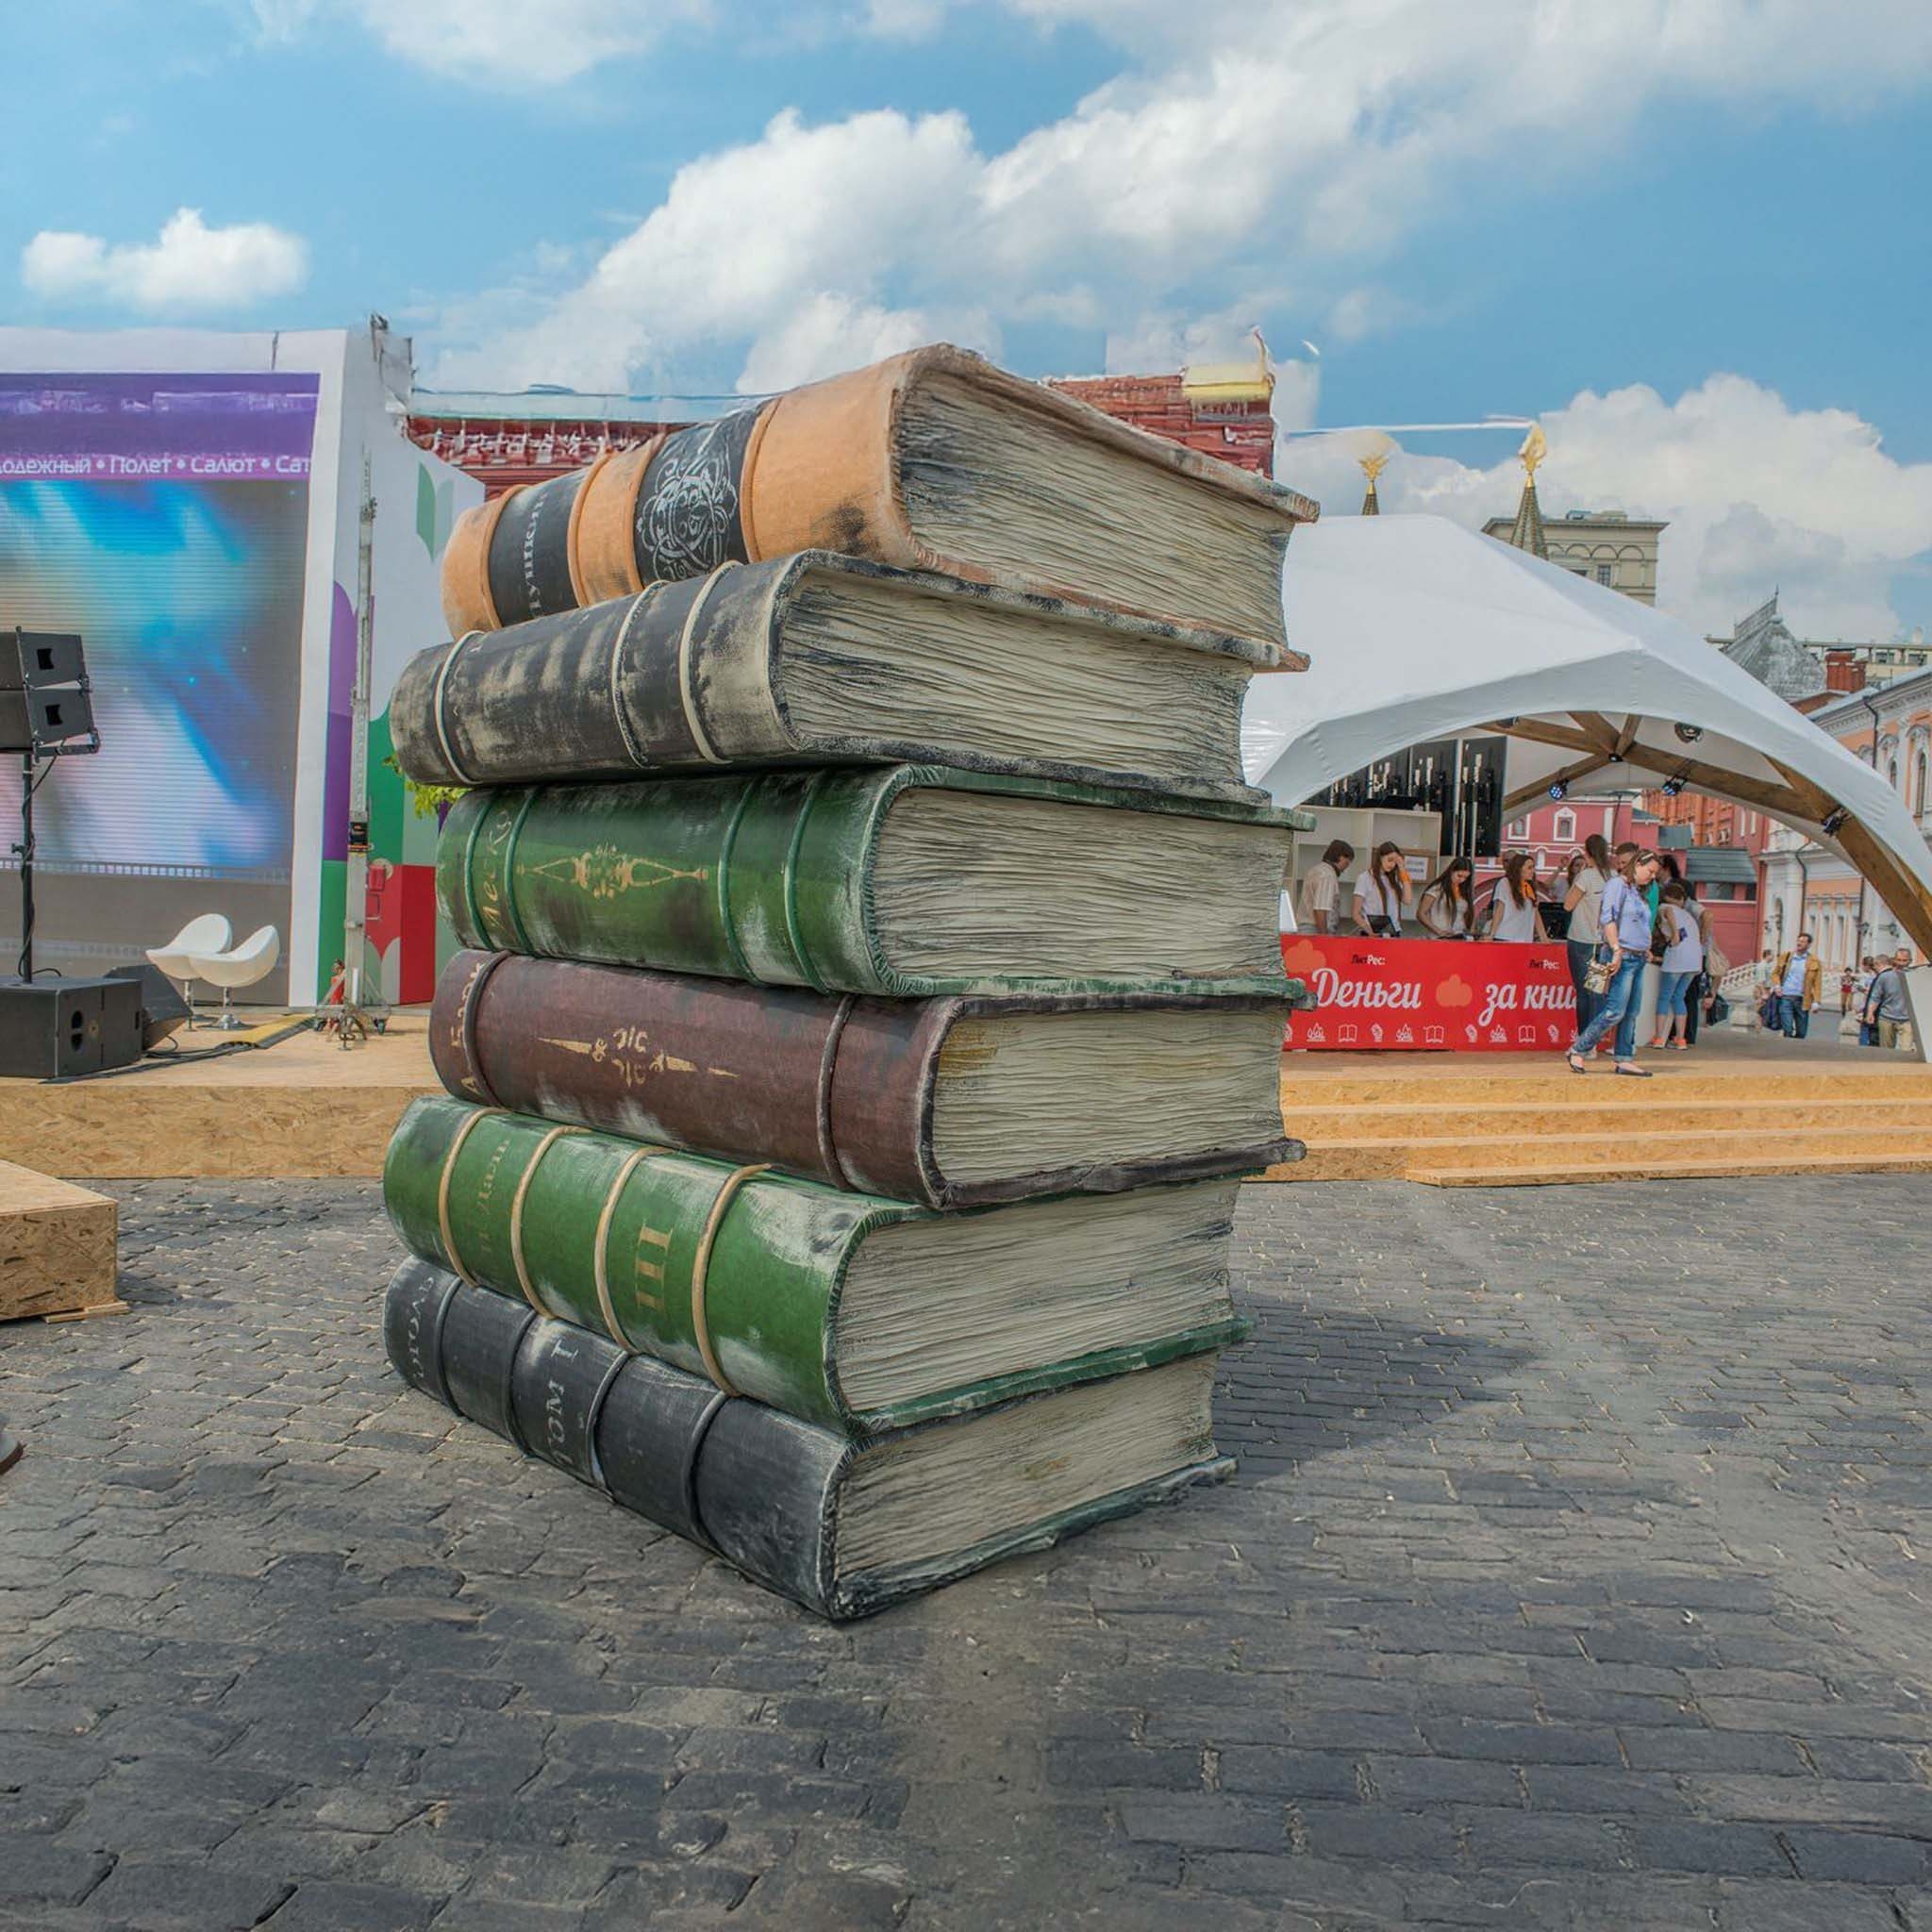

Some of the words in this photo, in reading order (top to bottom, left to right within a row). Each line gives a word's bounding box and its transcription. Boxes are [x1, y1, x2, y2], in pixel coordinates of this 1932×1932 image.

[0, 455, 92, 475] одежный
[109, 455, 171, 474] Полет
[191, 456, 257, 474] Салют
[275, 457, 311, 474] Сат
[1312, 968, 1422, 1009] Деньги
[1478, 983, 1518, 1026] за
